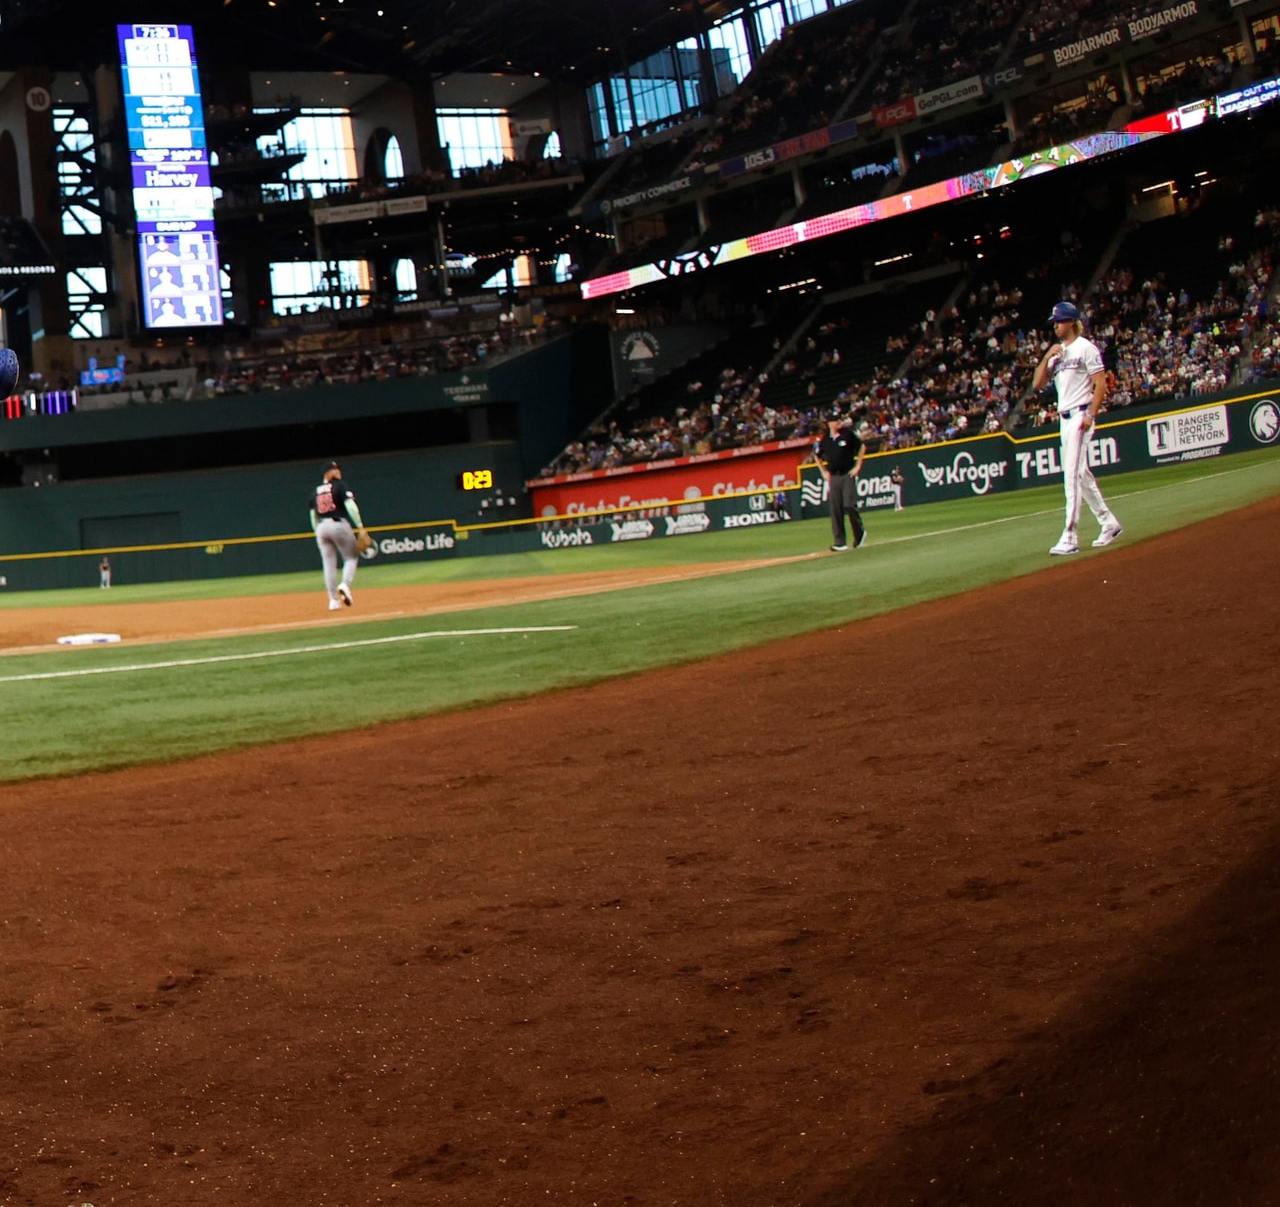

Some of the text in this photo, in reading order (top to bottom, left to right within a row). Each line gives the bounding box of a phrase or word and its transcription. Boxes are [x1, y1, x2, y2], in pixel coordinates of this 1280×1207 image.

[1128, 1, 1198, 36] BODYARMOR
[1053, 28, 1121, 63] BODYARMOR
[30, 92, 49, 107] 10
[918, 83, 978, 111] GoPGL.com
[1243, 84, 1263, 97] OUT
[743, 147, 776, 170] 105.3
[145, 170, 199, 187] Harvey
[1177, 411, 1220, 428] RANGERS
[1179, 423, 1214, 437] SPORTS
[1179, 430, 1225, 446] NETWORK
[946, 452, 1008, 494] Kroger
[380, 533, 455, 555] Globe Life
[541, 528, 592, 549] Kubota
